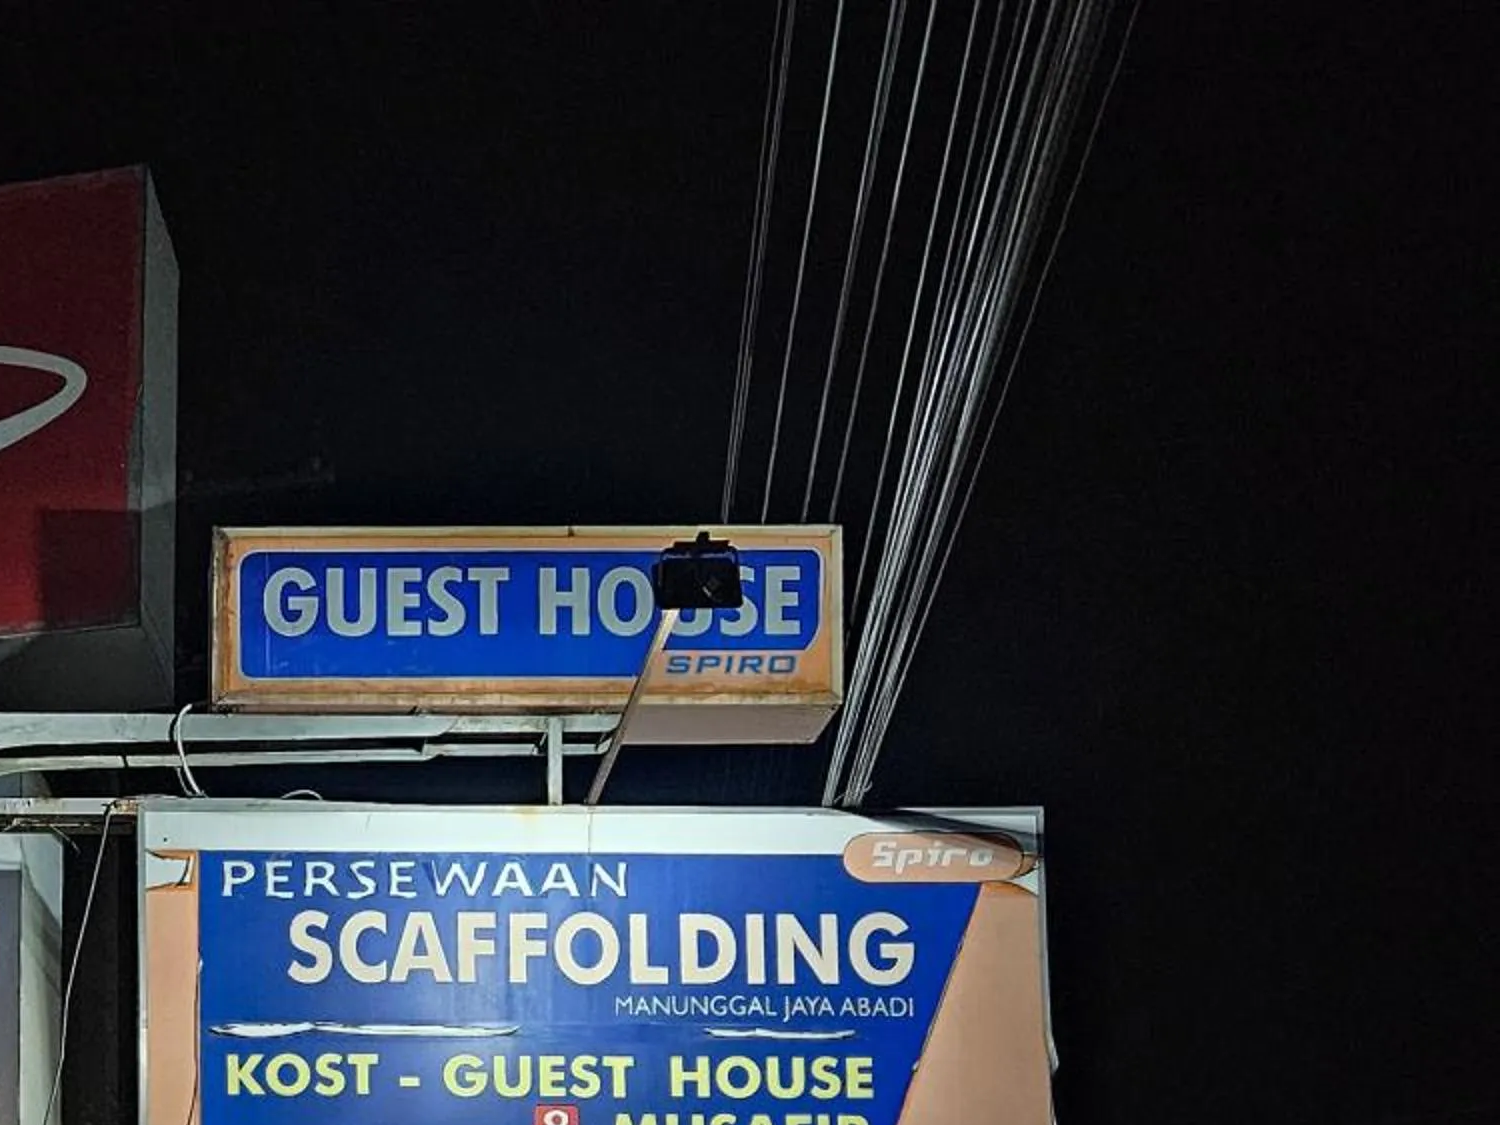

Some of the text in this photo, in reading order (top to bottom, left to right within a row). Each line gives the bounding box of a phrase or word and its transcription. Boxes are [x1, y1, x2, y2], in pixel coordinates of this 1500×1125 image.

[262, 565, 509, 638] GUEST
[665, 654, 797, 674] SPIRO
[871, 840, 996, 874] Spiro
[221, 859, 628, 899] PERSEWAAN
[286, 909, 916, 986] SCAFFOLDING
[615, 995, 914, 1023] MANUNGGAL JAYA ABADI
[225, 1053, 380, 1096] KOST
[442, 1053, 635, 1099] GUEST
[669, 1055, 875, 1099] HOUSE
